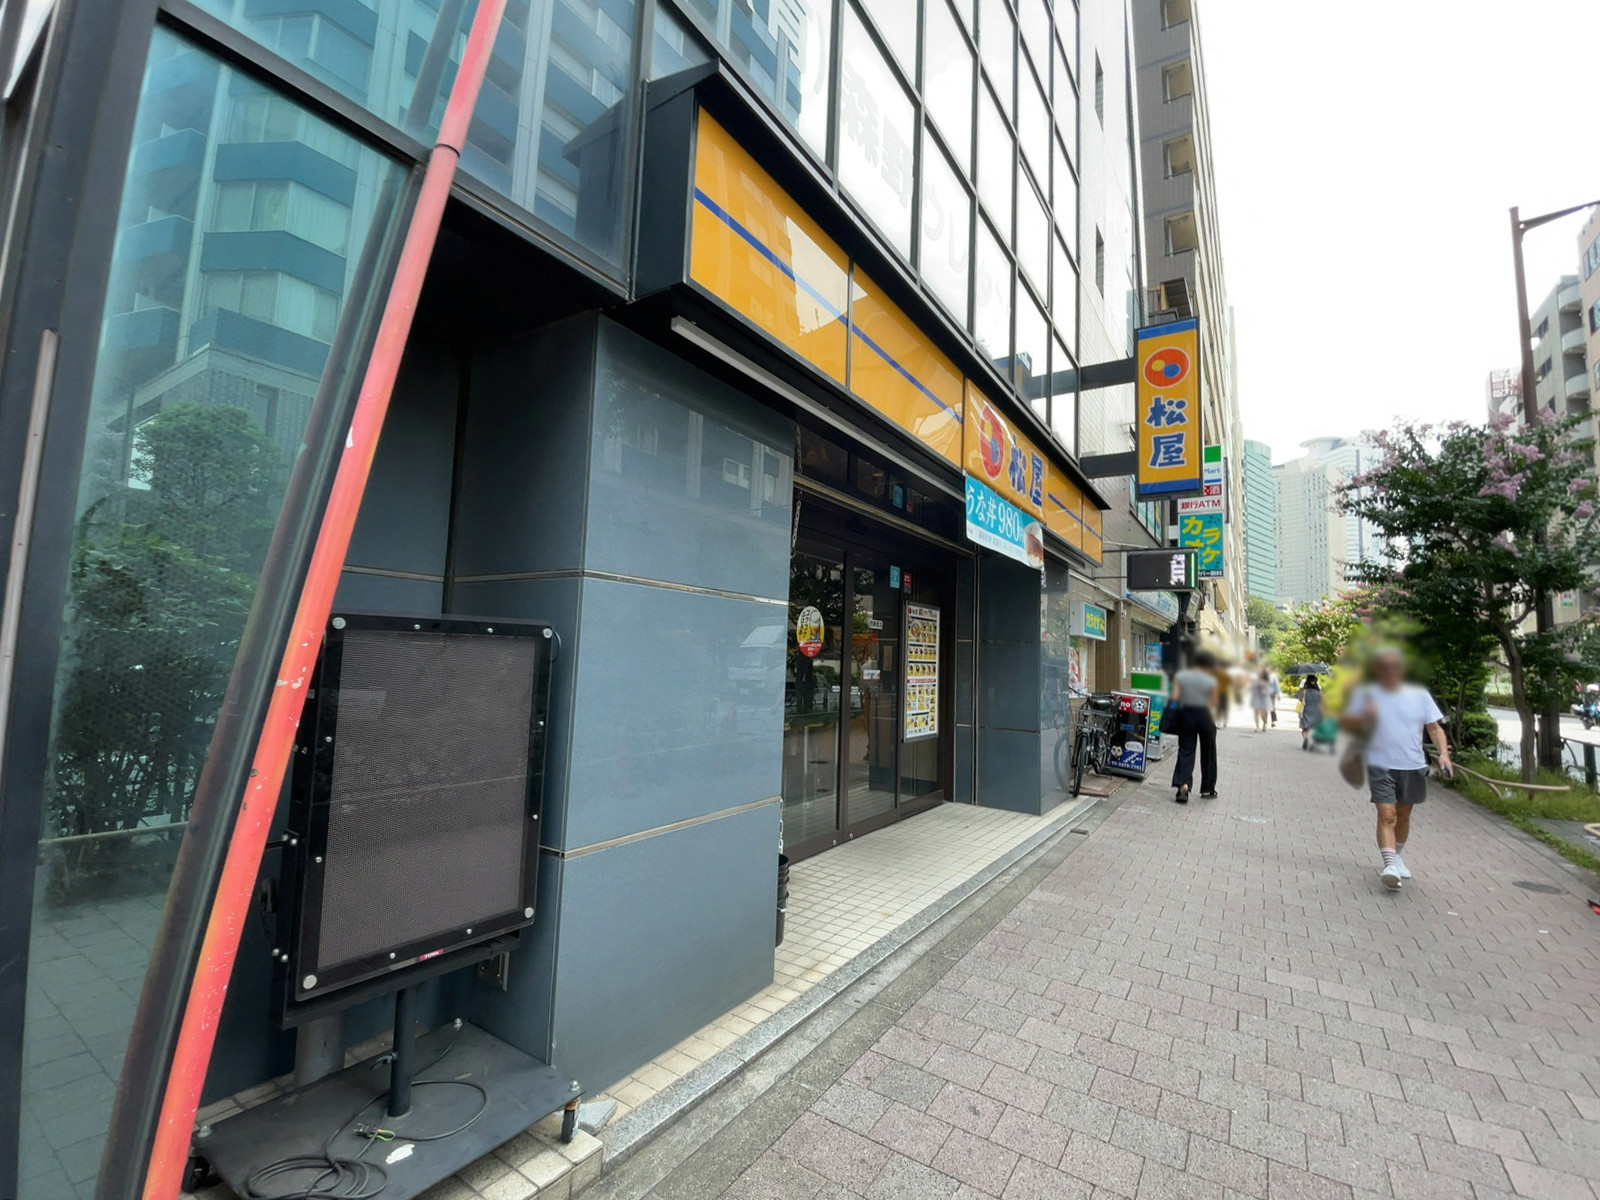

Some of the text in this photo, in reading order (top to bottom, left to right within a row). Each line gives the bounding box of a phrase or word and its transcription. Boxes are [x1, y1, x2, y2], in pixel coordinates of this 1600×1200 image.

[1146, 396, 1187, 468] 松屋
[1008, 432, 1043, 508] 松屋
[1181, 499, 1221, 510] 銀行ATM
